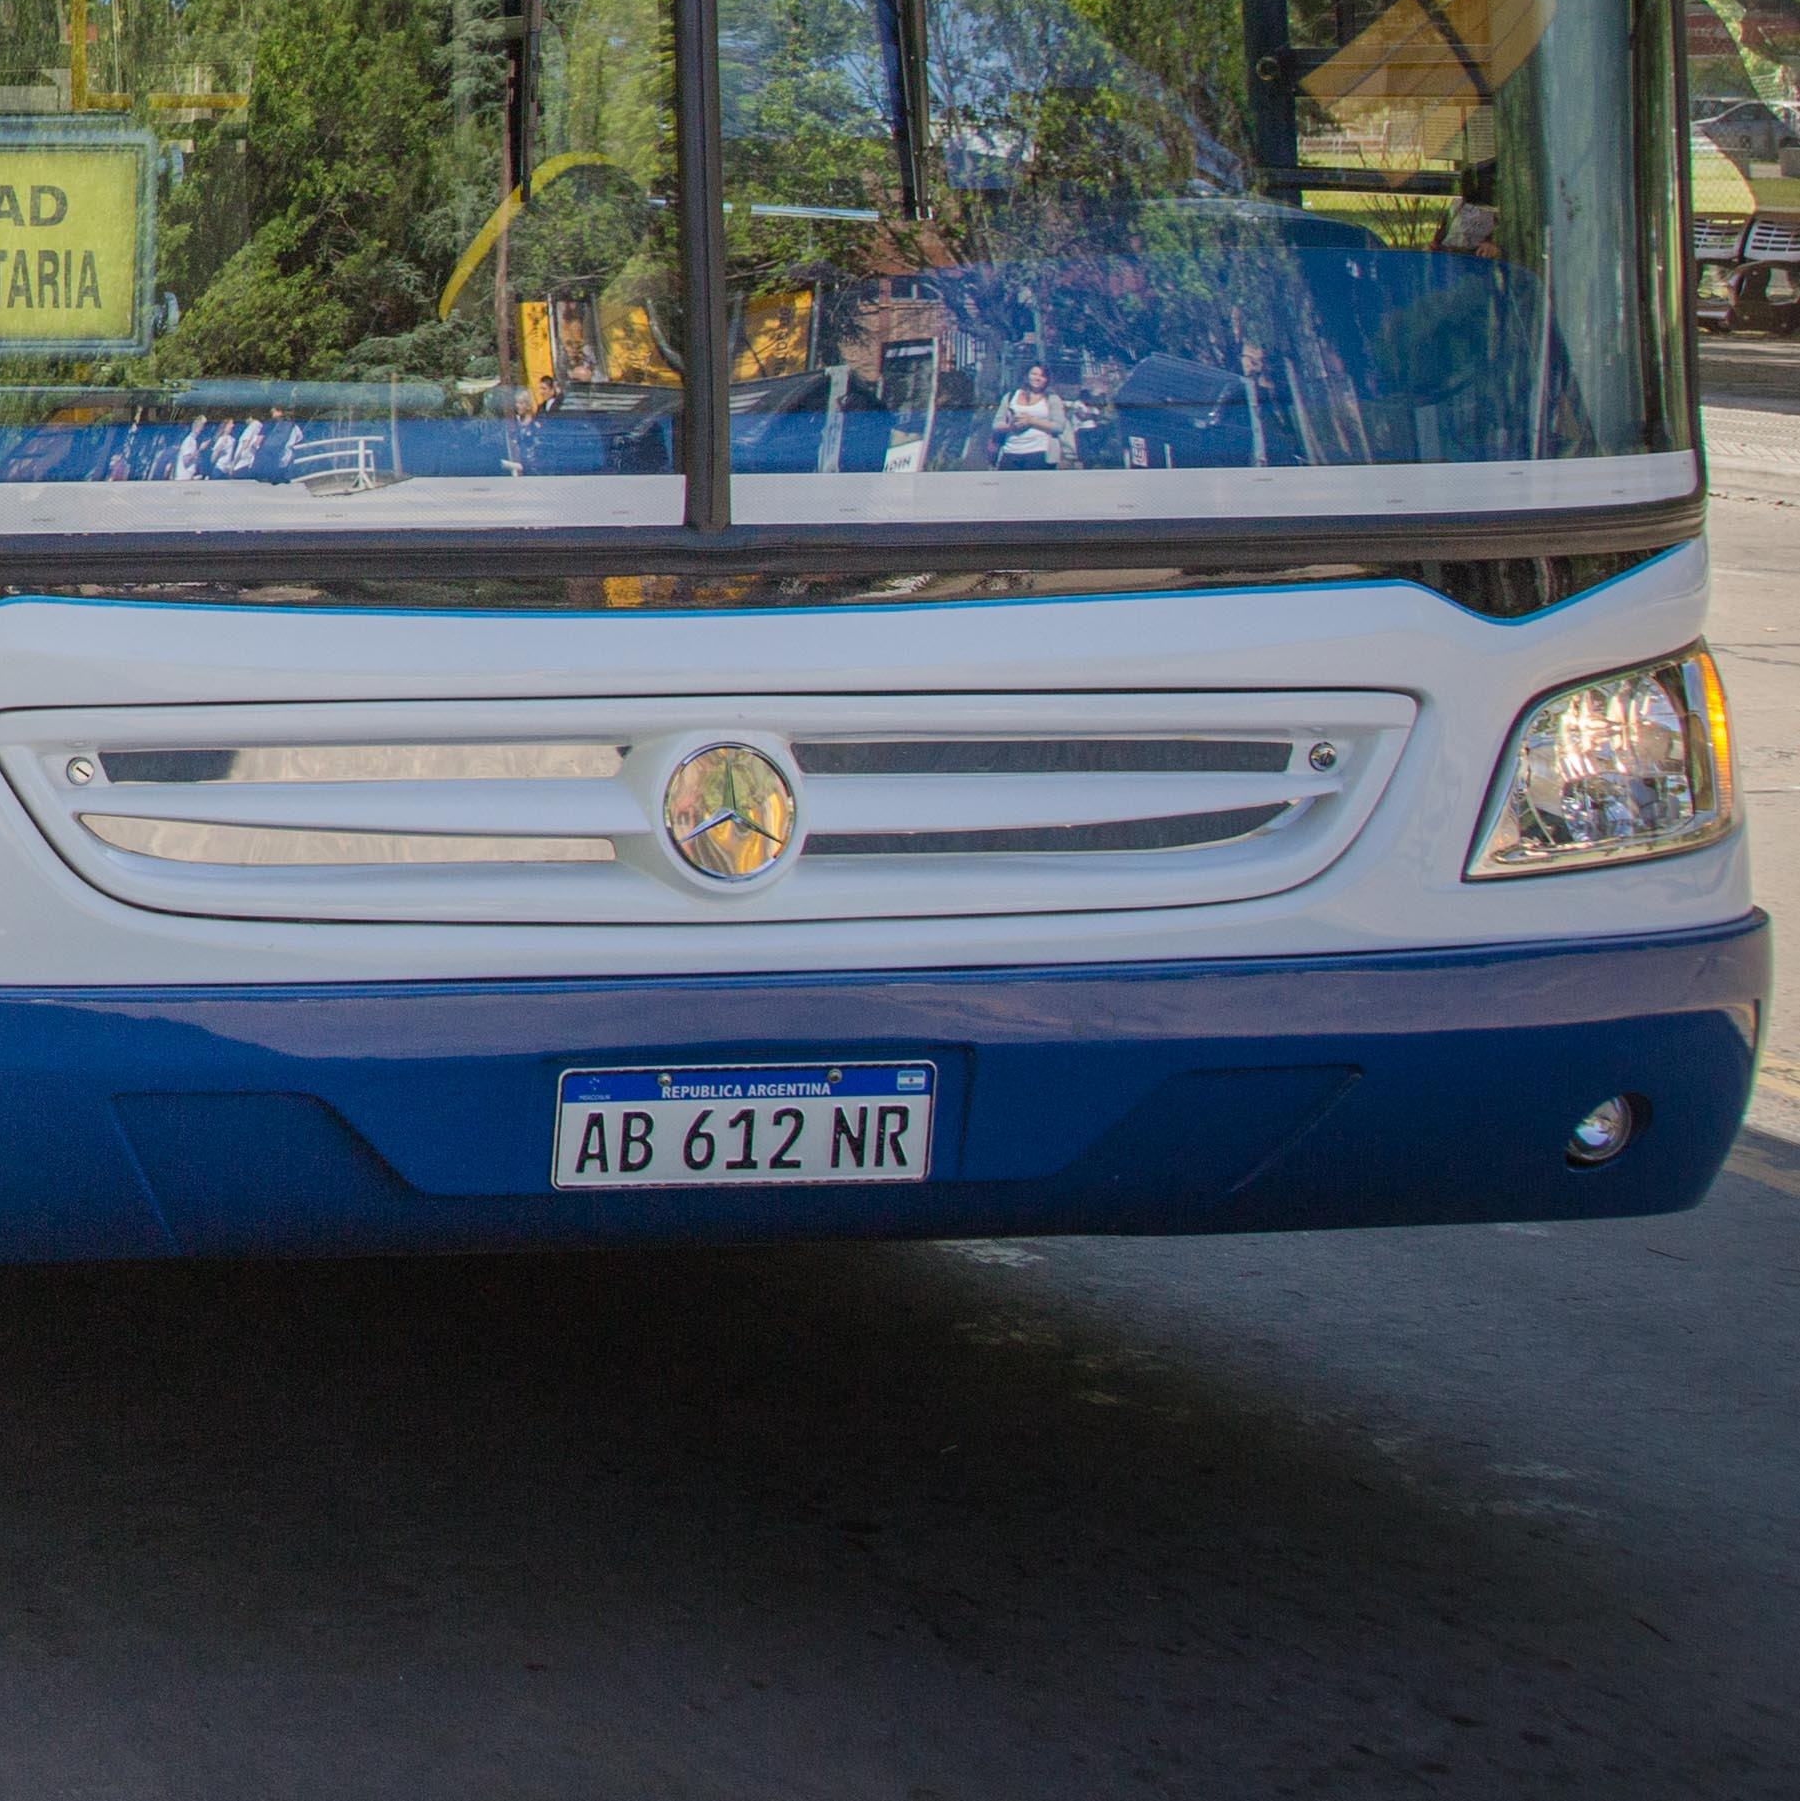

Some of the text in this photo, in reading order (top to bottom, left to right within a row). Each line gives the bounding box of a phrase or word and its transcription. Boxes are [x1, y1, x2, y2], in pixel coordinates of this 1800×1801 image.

[661, 1082, 832, 1099] REPUBLICA ARGENTINA
[575, 1105, 910, 1174] AB 612 NR
